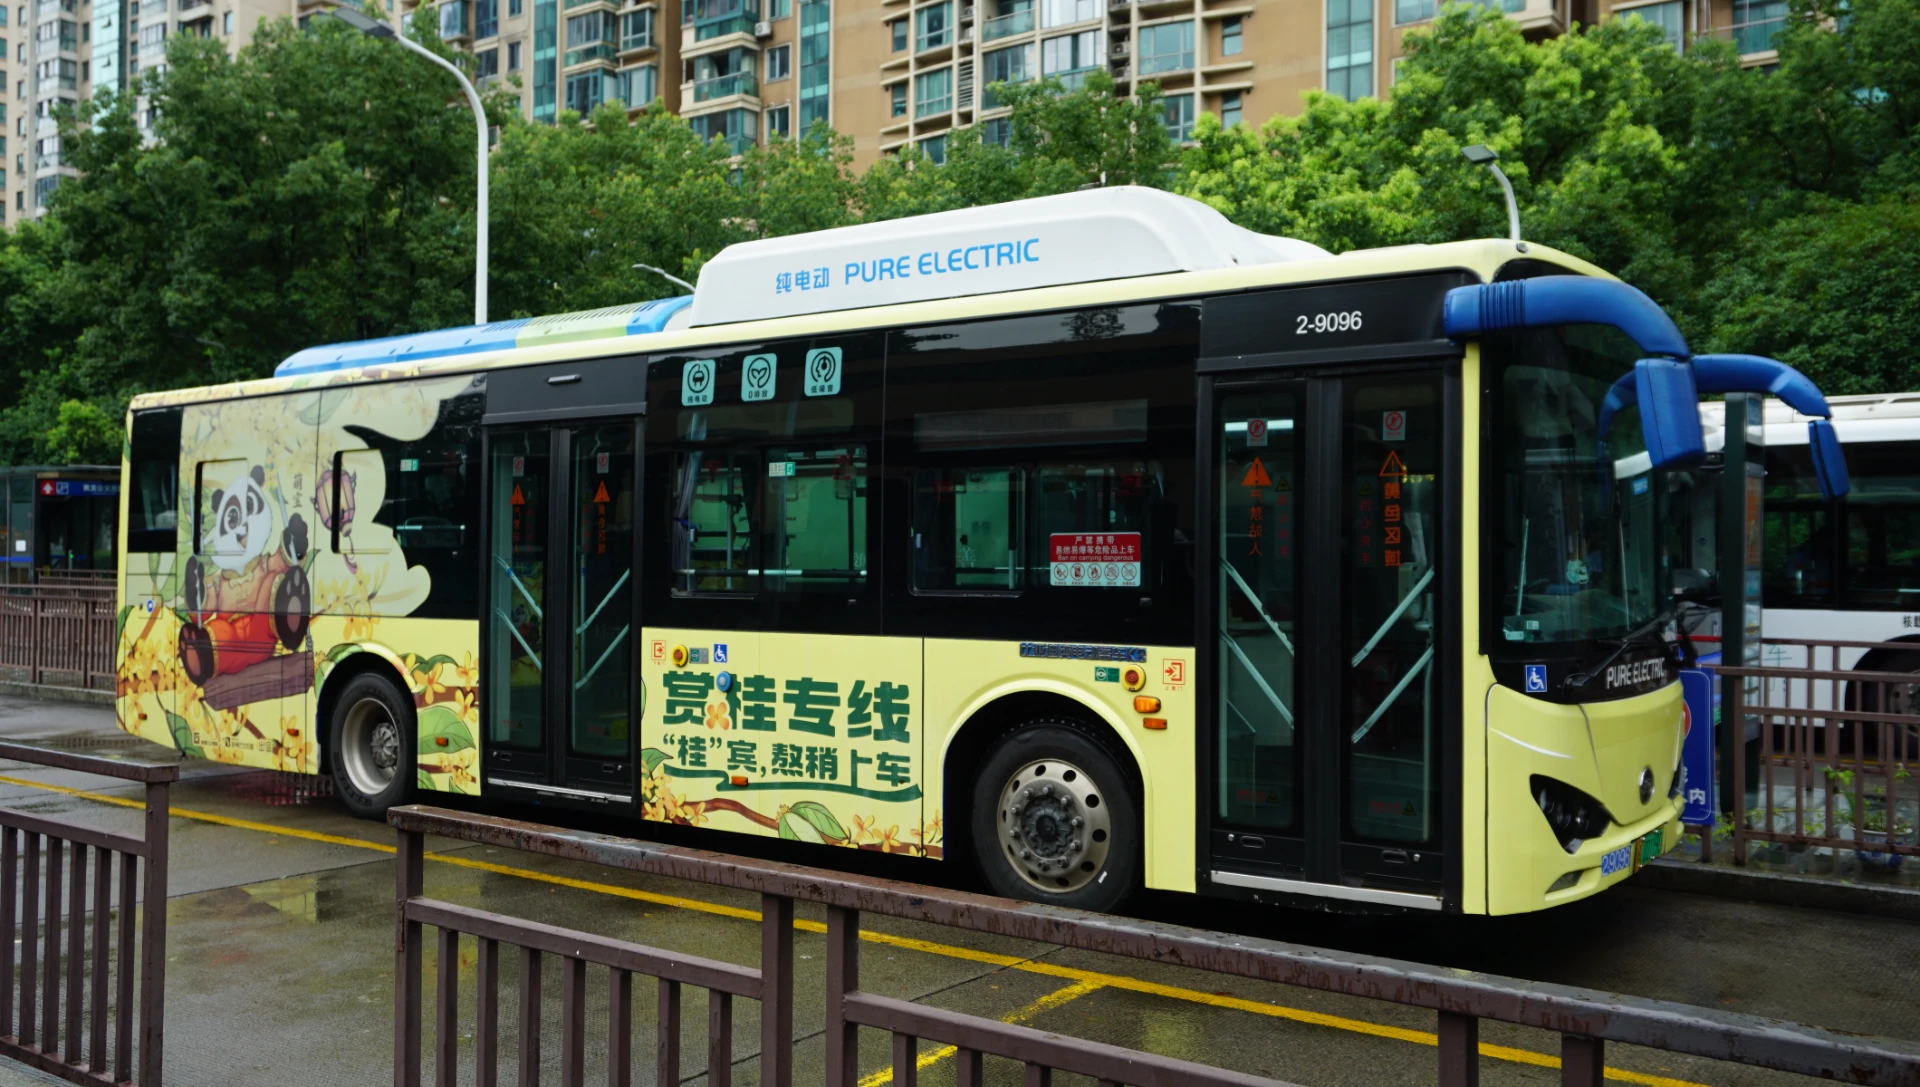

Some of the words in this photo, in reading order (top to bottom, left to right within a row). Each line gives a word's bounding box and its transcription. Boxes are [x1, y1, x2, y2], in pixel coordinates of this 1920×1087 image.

[776, 266, 830, 294] 纯电动
[845, 255, 910, 285] PURE
[917, 238, 1040, 275] ELECTRIC
[1296, 310, 1363, 335] 2-9096
[1103, 554, 1134, 562] dangerous
[1606, 664, 1632, 689] PURE
[1633, 657, 1665, 683] ELECTRIC
[662, 670, 911, 744] 赏桂专线
